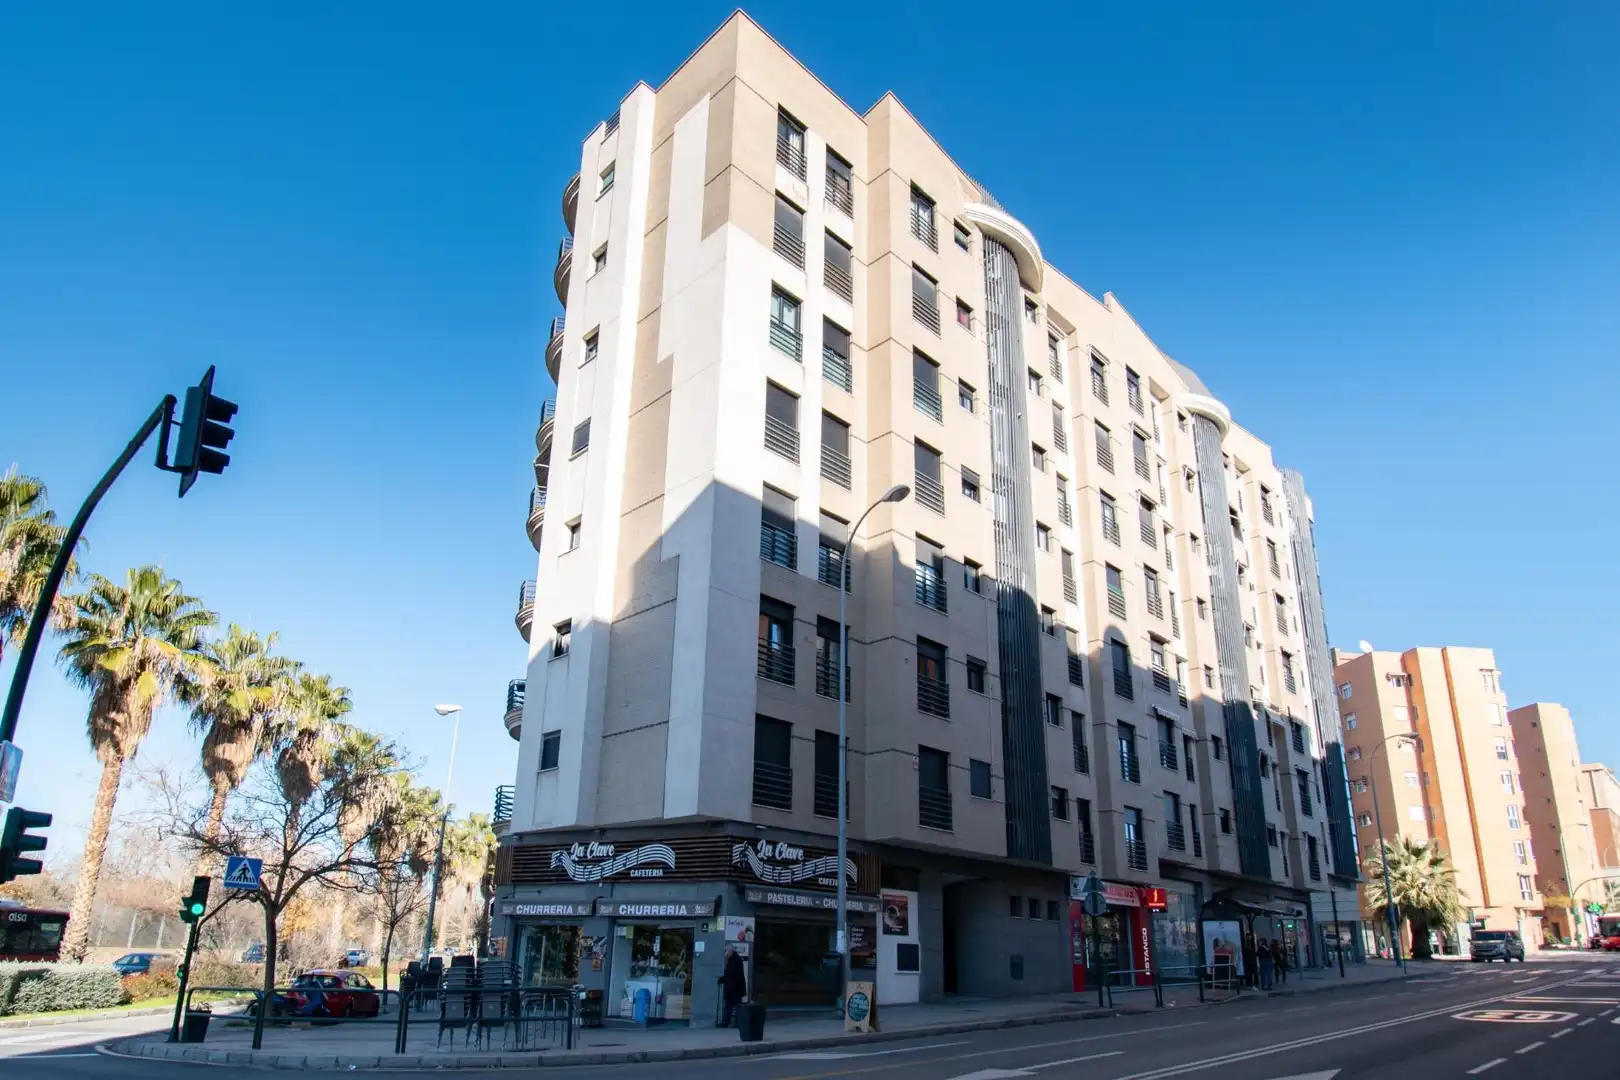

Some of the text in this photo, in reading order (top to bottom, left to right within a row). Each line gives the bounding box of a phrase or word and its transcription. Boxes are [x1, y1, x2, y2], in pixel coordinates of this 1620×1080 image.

[570, 841, 615, 861] La Clave
[757, 839, 804, 860] La Clave
[630, 868, 663, 878] CAFETERIA
[767, 893, 813, 906] PASTELERIA
[516, 904, 573, 914] CHURRERIA
[619, 904, 687, 915] CHURRERIA
